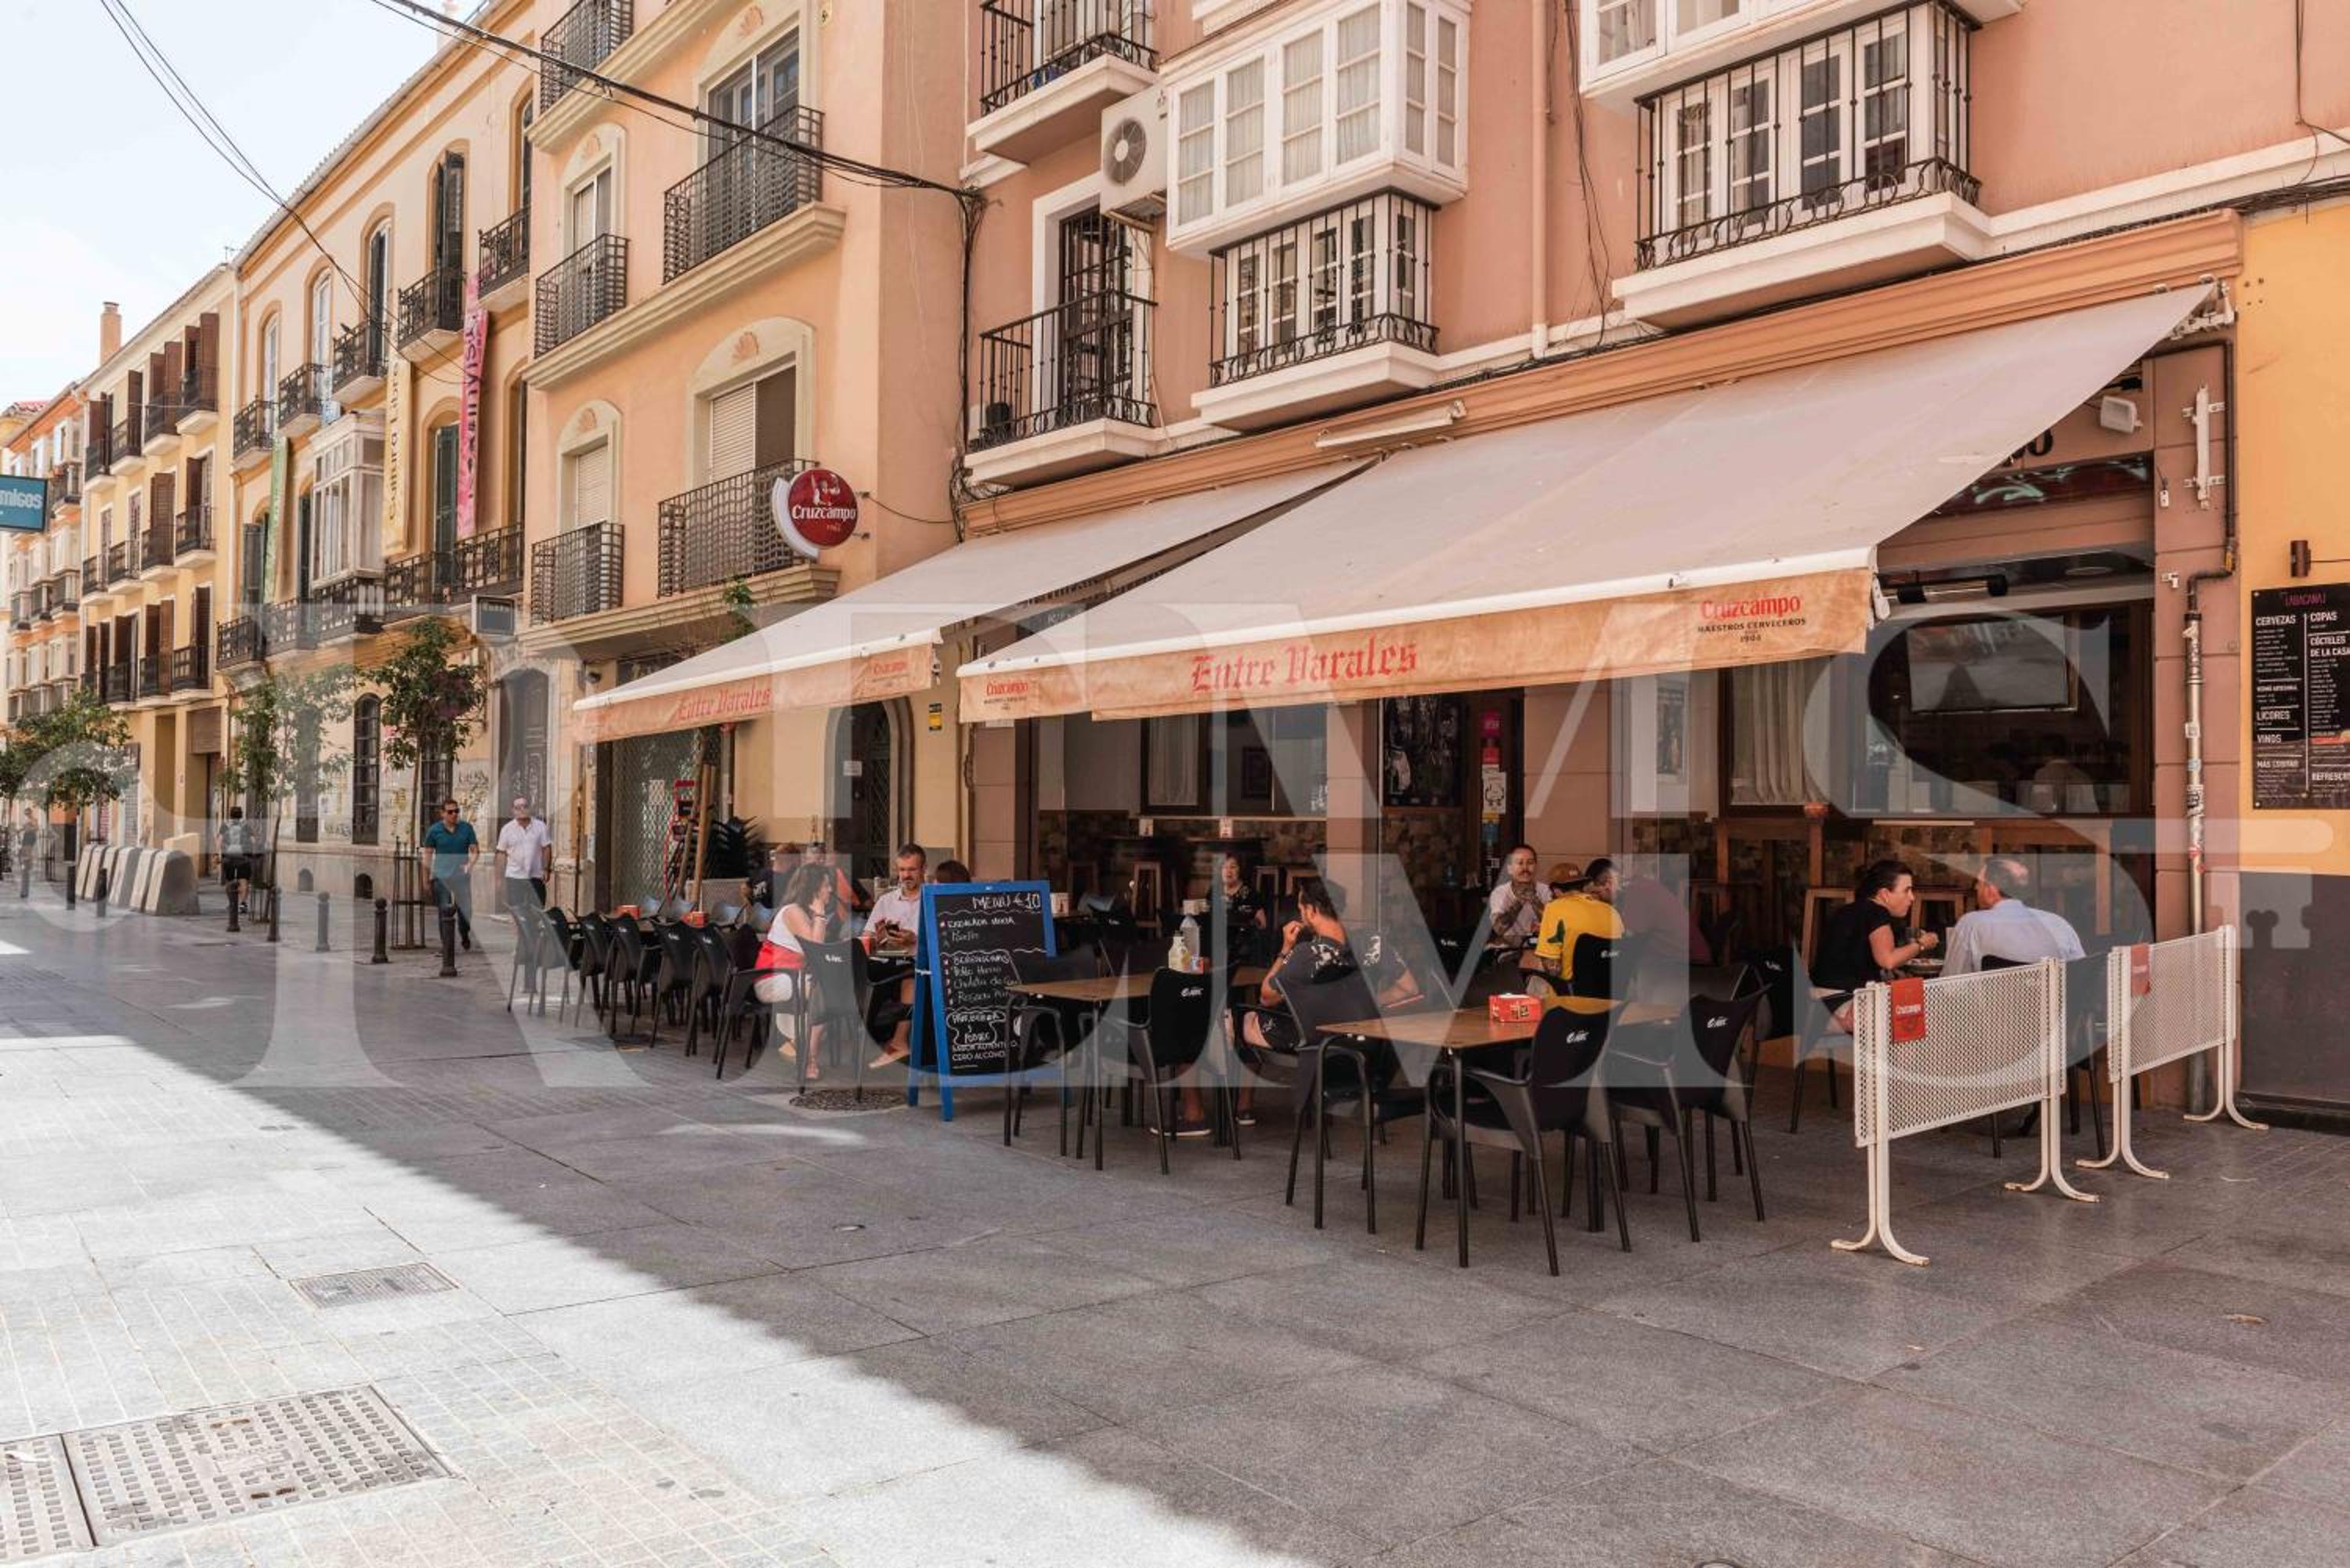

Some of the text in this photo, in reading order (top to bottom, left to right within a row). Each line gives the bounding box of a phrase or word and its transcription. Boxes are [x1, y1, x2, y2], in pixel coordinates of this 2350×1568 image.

[791, 504, 856, 522] Cruzcampo
[1701, 595, 1802, 620] Cruzcampo
[2255, 615, 2297, 626] CERVEZAS
[2310, 611, 2337, 623] COPAS
[1747, 617, 1806, 630] CERVECEROS
[2310, 648, 2319, 656] DE
[2321, 647, 2331, 656] LA
[2256, 710, 2290, 721] LICORES
[2257, 734, 2282, 743] VINOS
[953, 1053, 973, 1061] CERO
